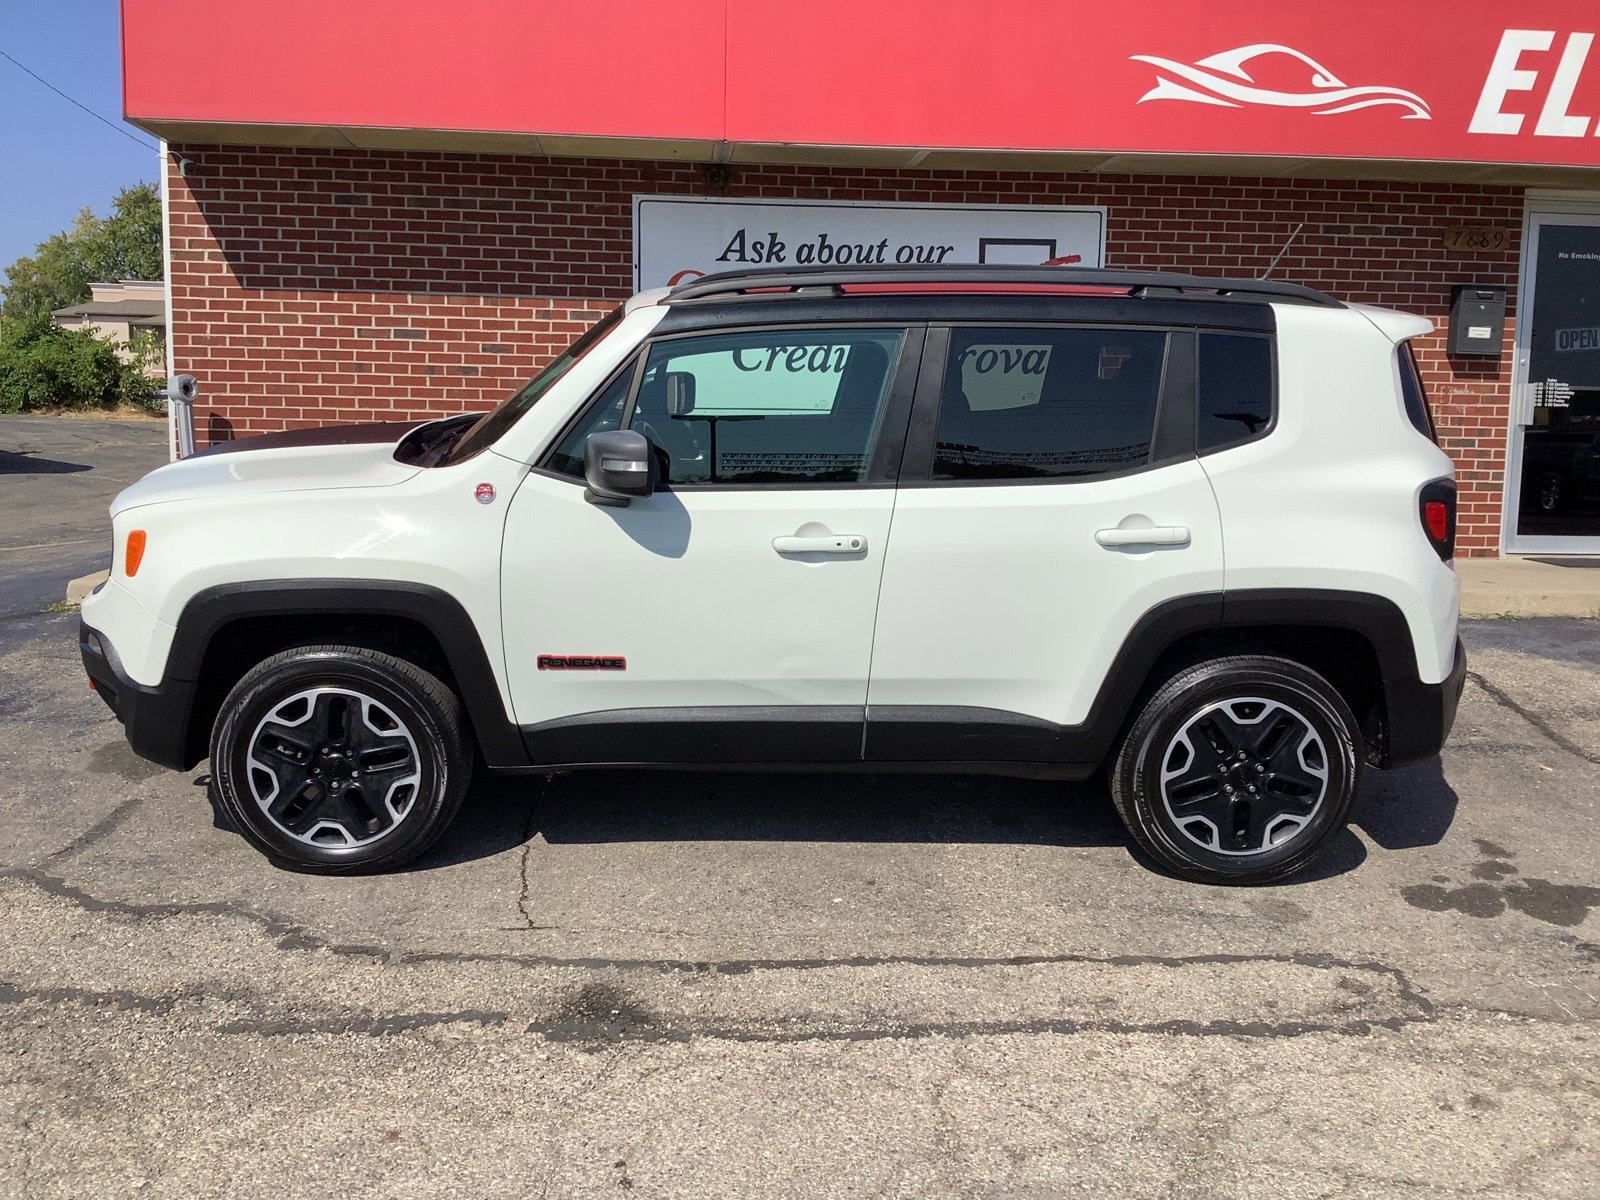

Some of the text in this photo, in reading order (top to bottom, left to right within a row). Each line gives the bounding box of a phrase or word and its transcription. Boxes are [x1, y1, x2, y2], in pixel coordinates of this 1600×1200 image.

[1467, 29, 1600, 137] EL
[715, 228, 954, 264] Ask about our
[1452, 230, 1504, 249] 7889
[1559, 329, 1598, 350] OPEN
[538, 655, 625, 670] RENEGADE
